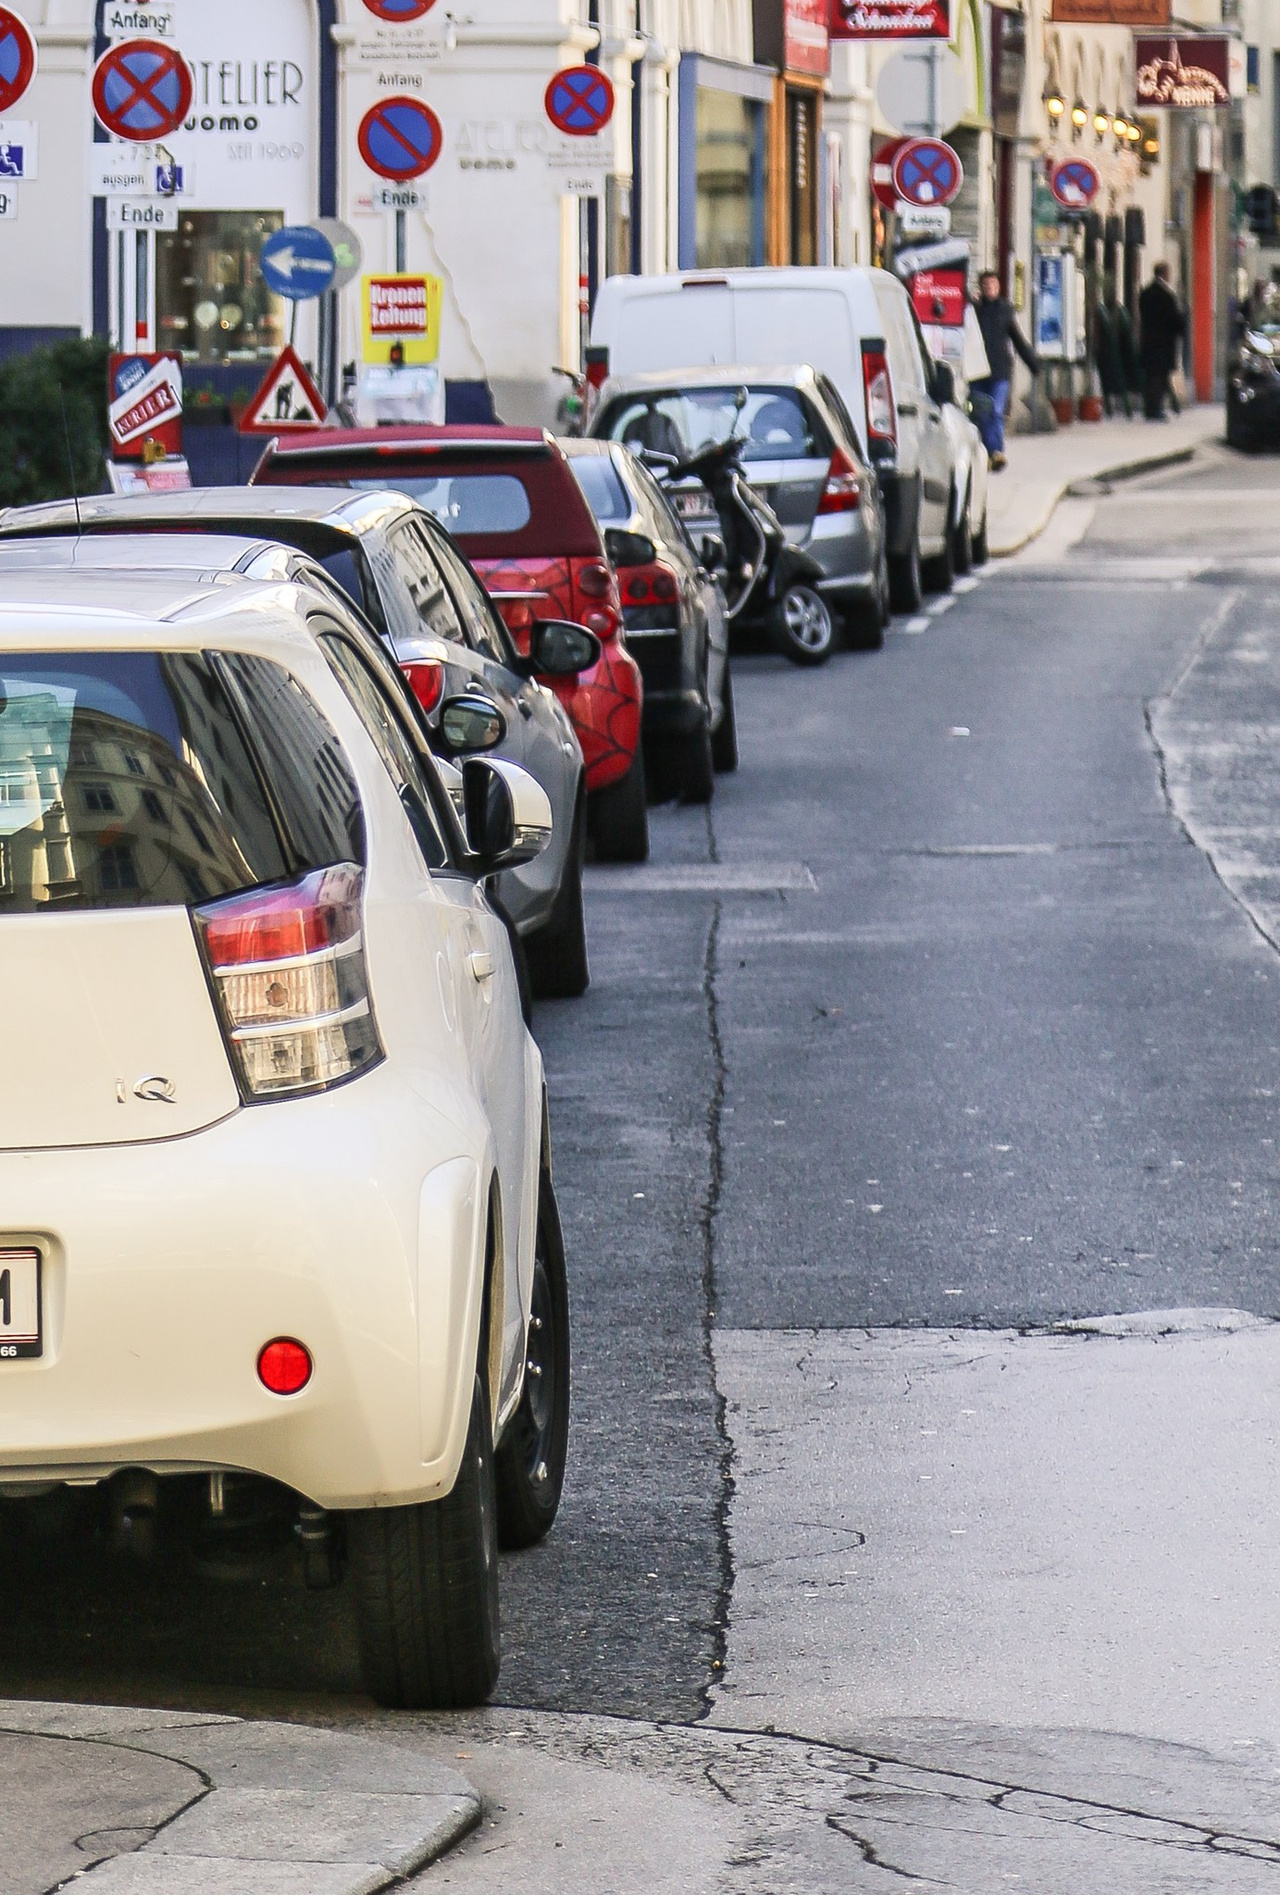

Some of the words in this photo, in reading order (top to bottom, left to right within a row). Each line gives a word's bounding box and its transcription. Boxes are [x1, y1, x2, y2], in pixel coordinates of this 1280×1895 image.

[111, 10, 167, 33] Anfang
[377, 71, 423, 88] Anfang
[184, 115, 258, 131] uomo
[381, 188, 420, 206] Ende
[120, 203, 165, 224] Ende
[370, 283, 427, 304] Kronen
[371, 304, 427, 327] Zeitung
[116, 387, 171, 435] KURIER
[0, 1345, 18, 1357] 66
